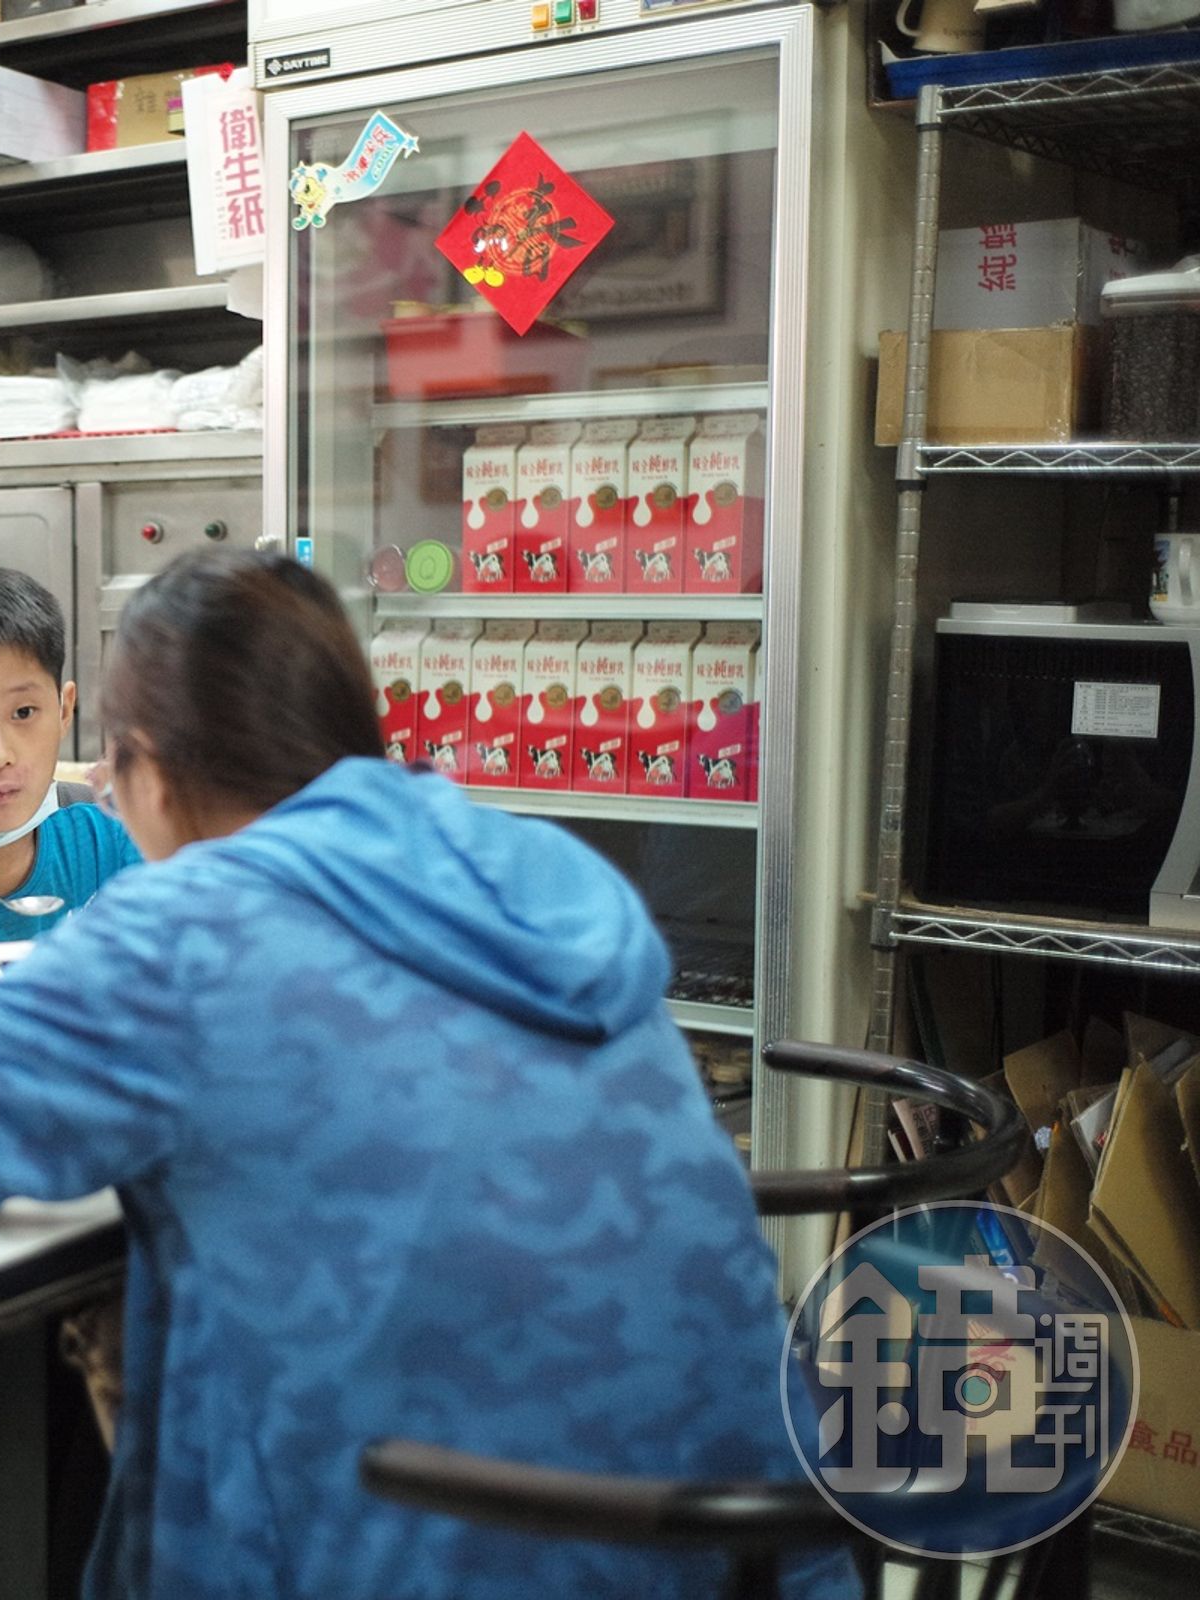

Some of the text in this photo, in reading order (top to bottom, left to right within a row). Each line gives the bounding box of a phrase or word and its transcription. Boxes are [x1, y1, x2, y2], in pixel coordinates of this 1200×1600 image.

[283, 54, 329, 71] DAYTIME
[220, 105, 265, 240] 衛生紙
